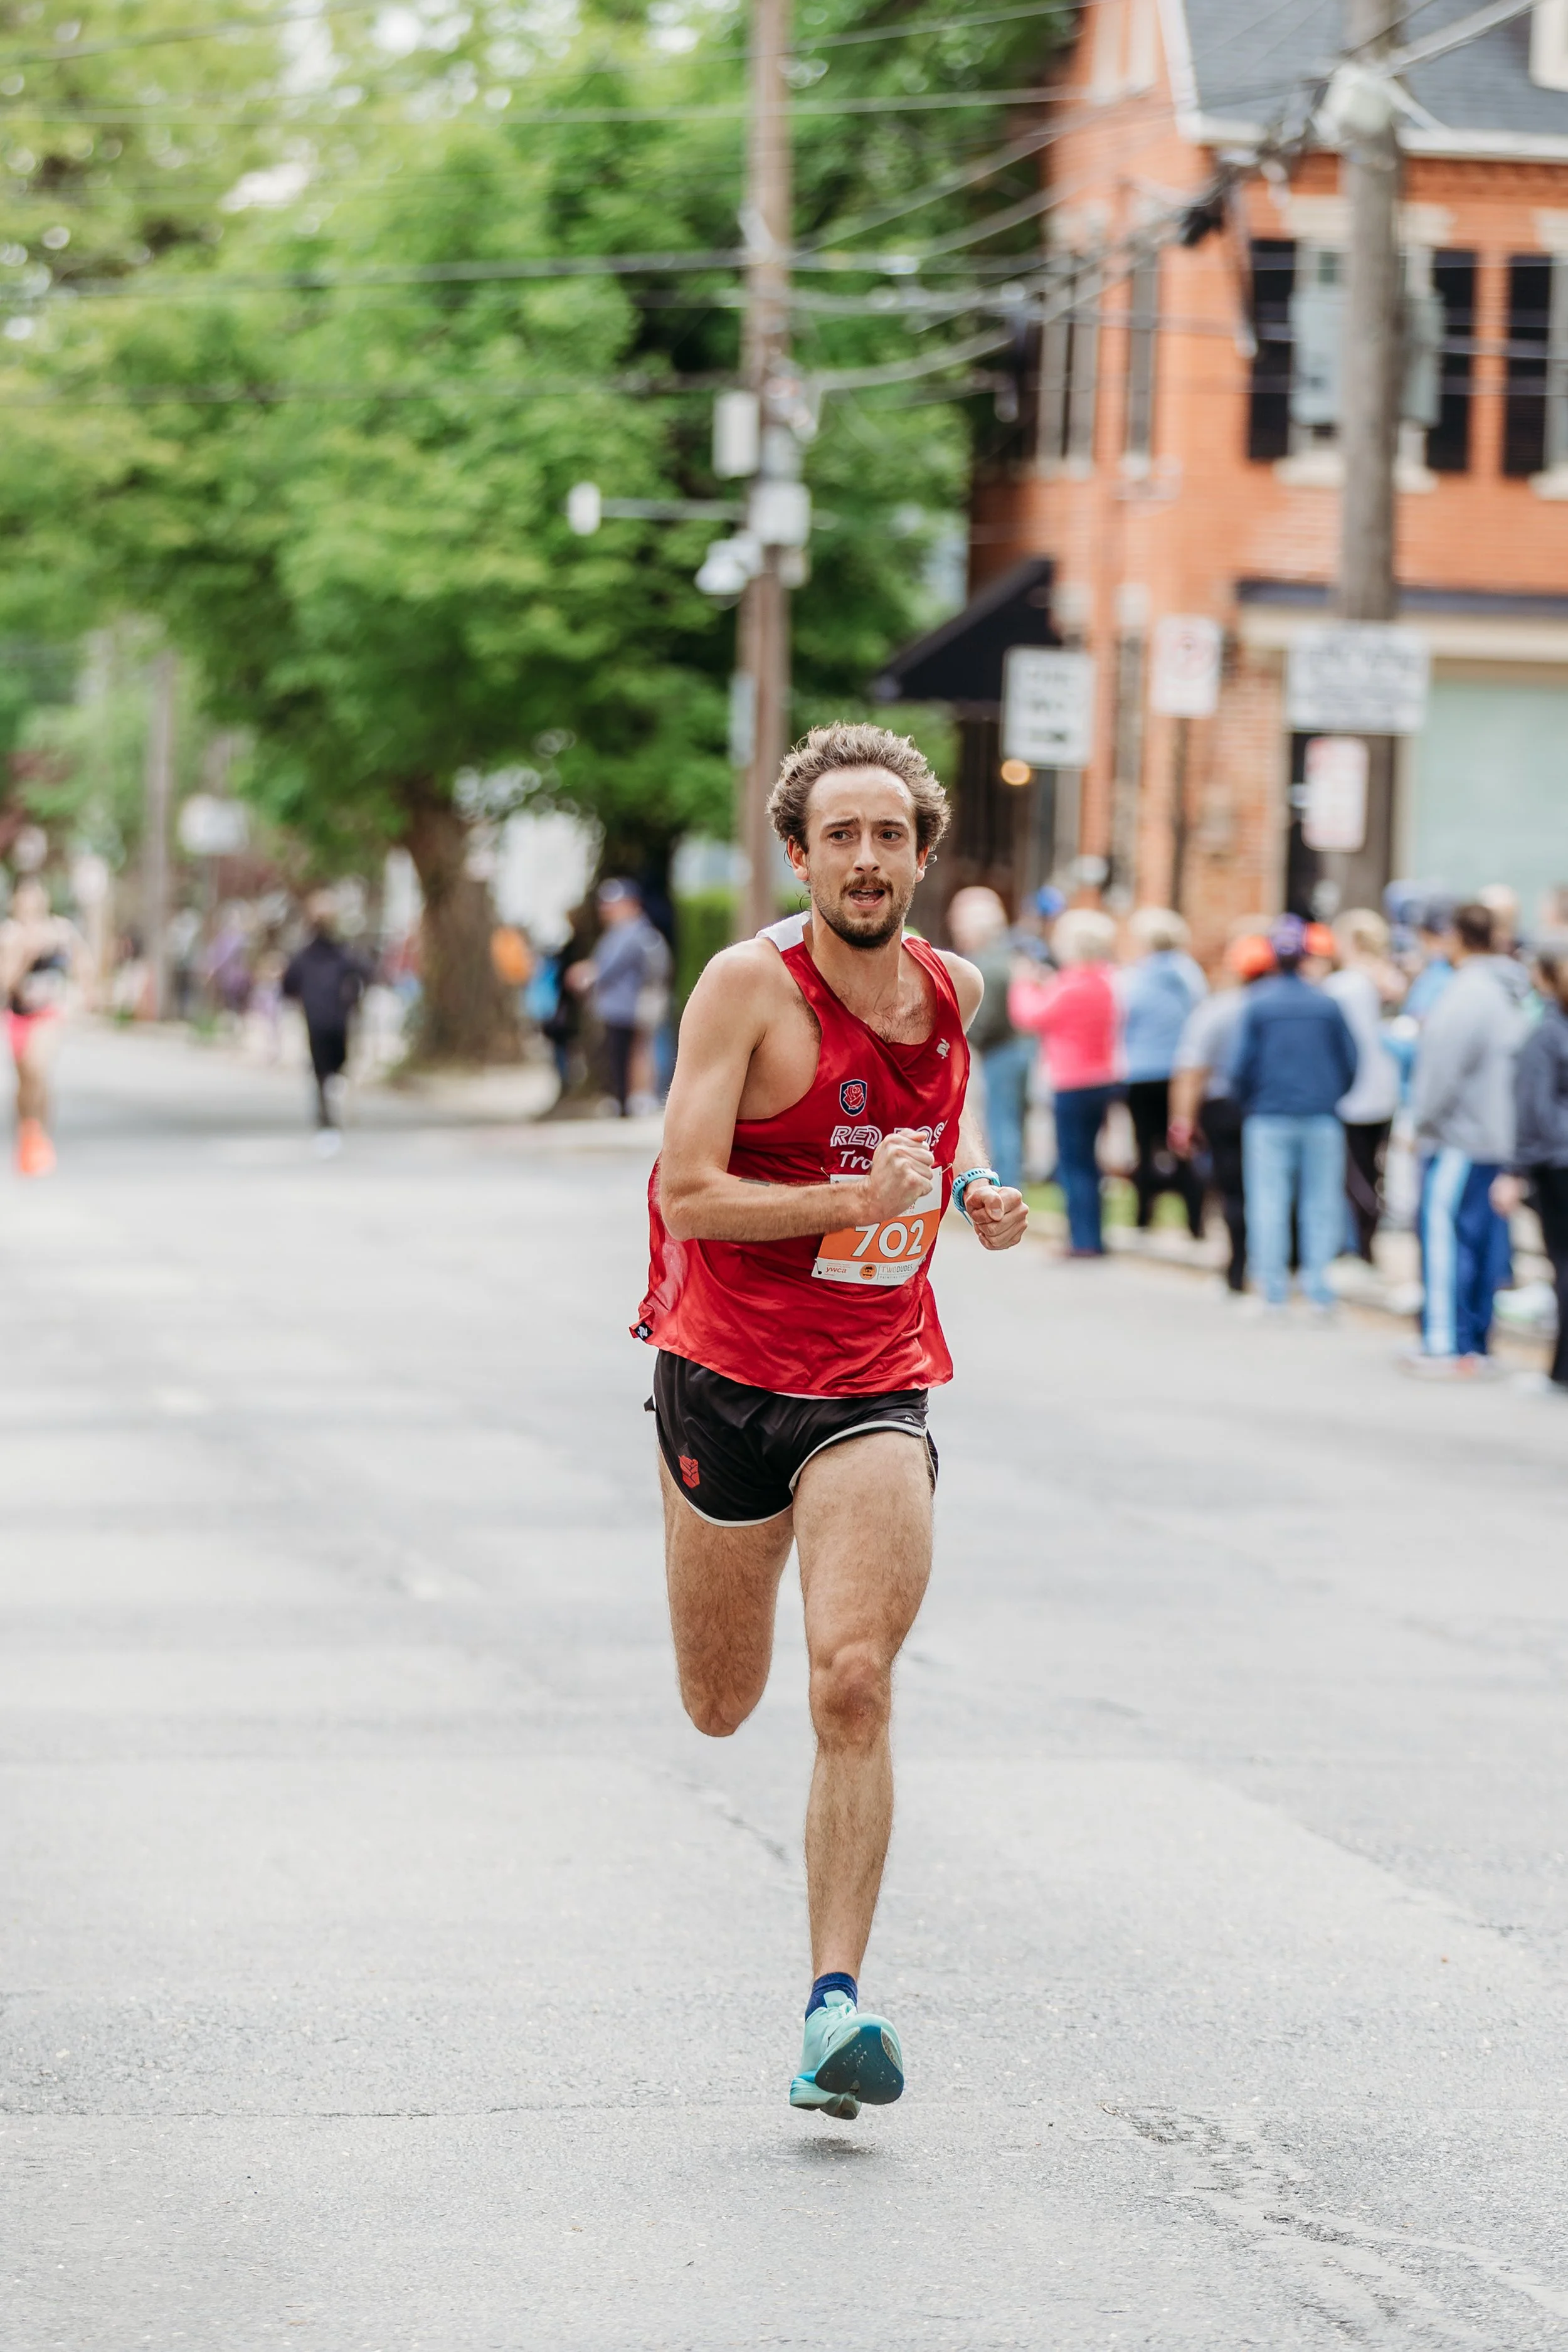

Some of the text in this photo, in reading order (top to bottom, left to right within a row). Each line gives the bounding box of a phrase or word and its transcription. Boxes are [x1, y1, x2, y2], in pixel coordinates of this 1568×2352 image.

[830, 1121, 945, 1150] RED OS
[840, 1149, 874, 1170] Tra
[850, 1218, 924, 1258] 702
